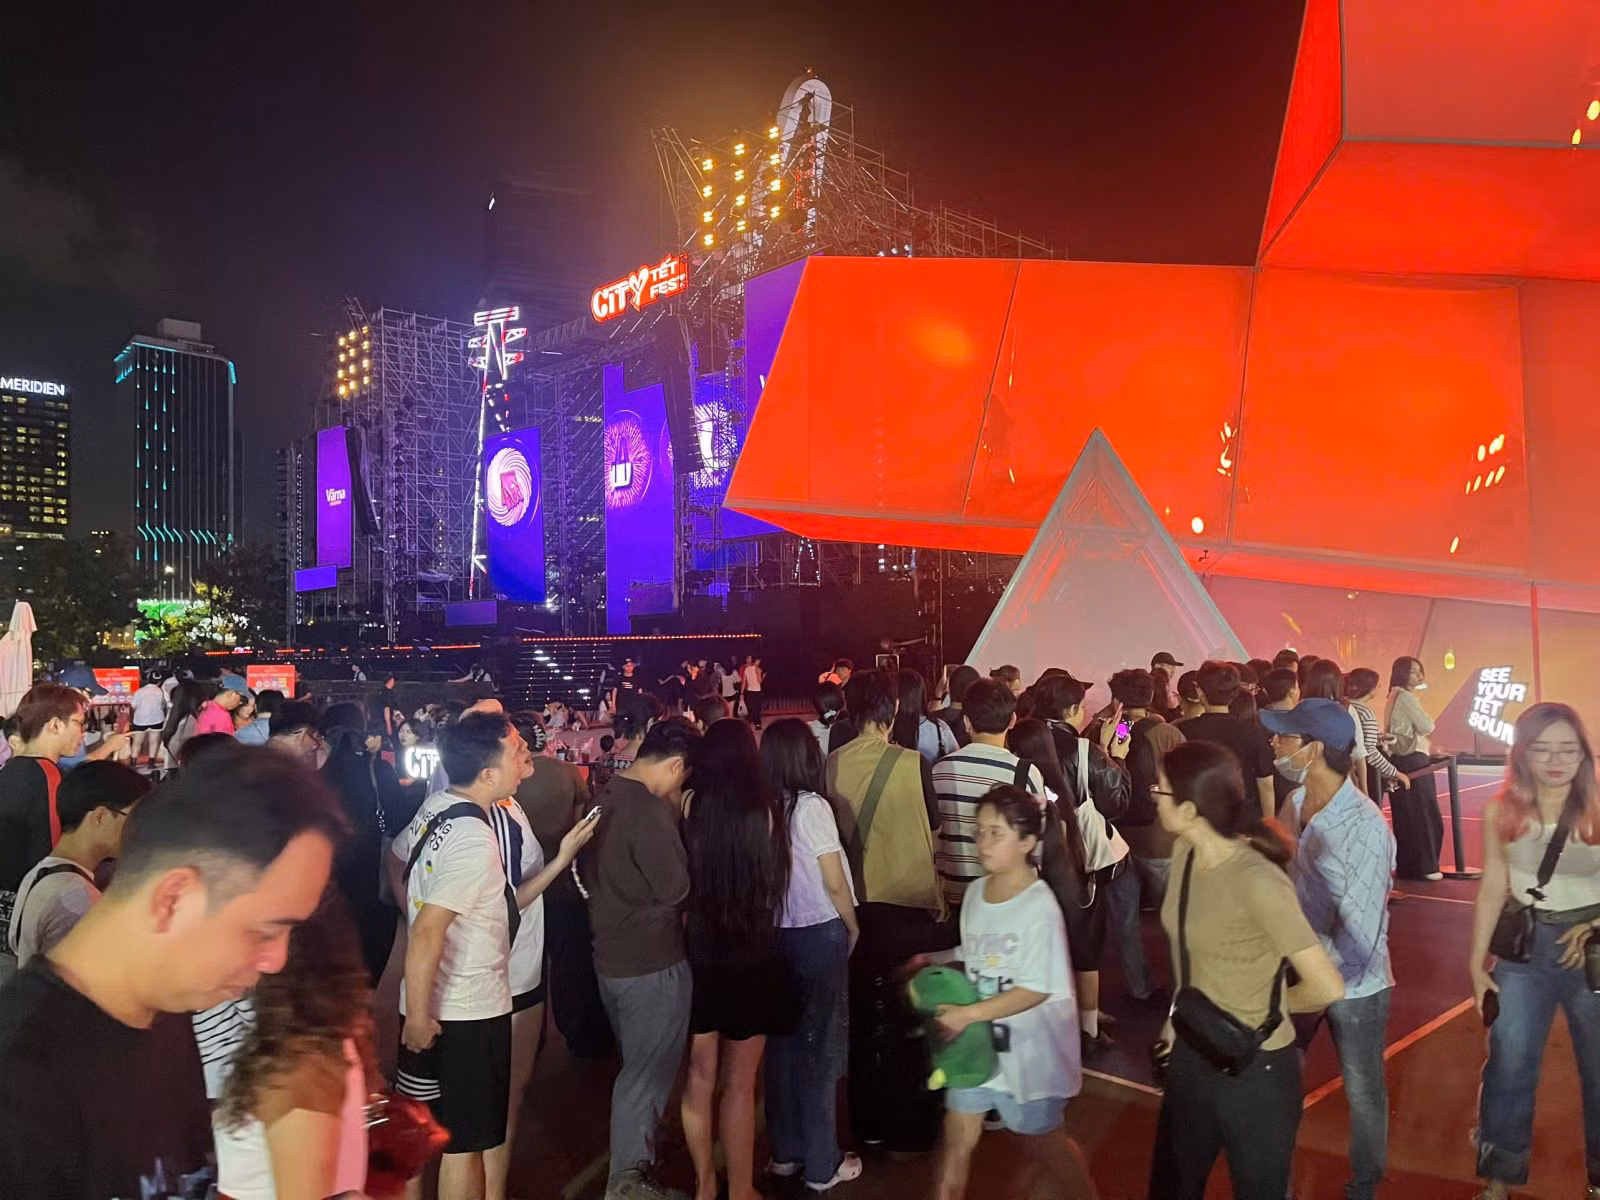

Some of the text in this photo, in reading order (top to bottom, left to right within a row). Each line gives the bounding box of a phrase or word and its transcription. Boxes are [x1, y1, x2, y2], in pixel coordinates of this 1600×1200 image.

[592, 267, 649, 318] CITY
[650, 273, 686, 299] FEST
[0, 376, 65, 396] MERIDIEN
[1480, 667, 1512, 683] SEE
[1478, 681, 1527, 703] YOUR
[1468, 711, 1514, 746] SOUN
[404, 746, 440, 779] CIT
